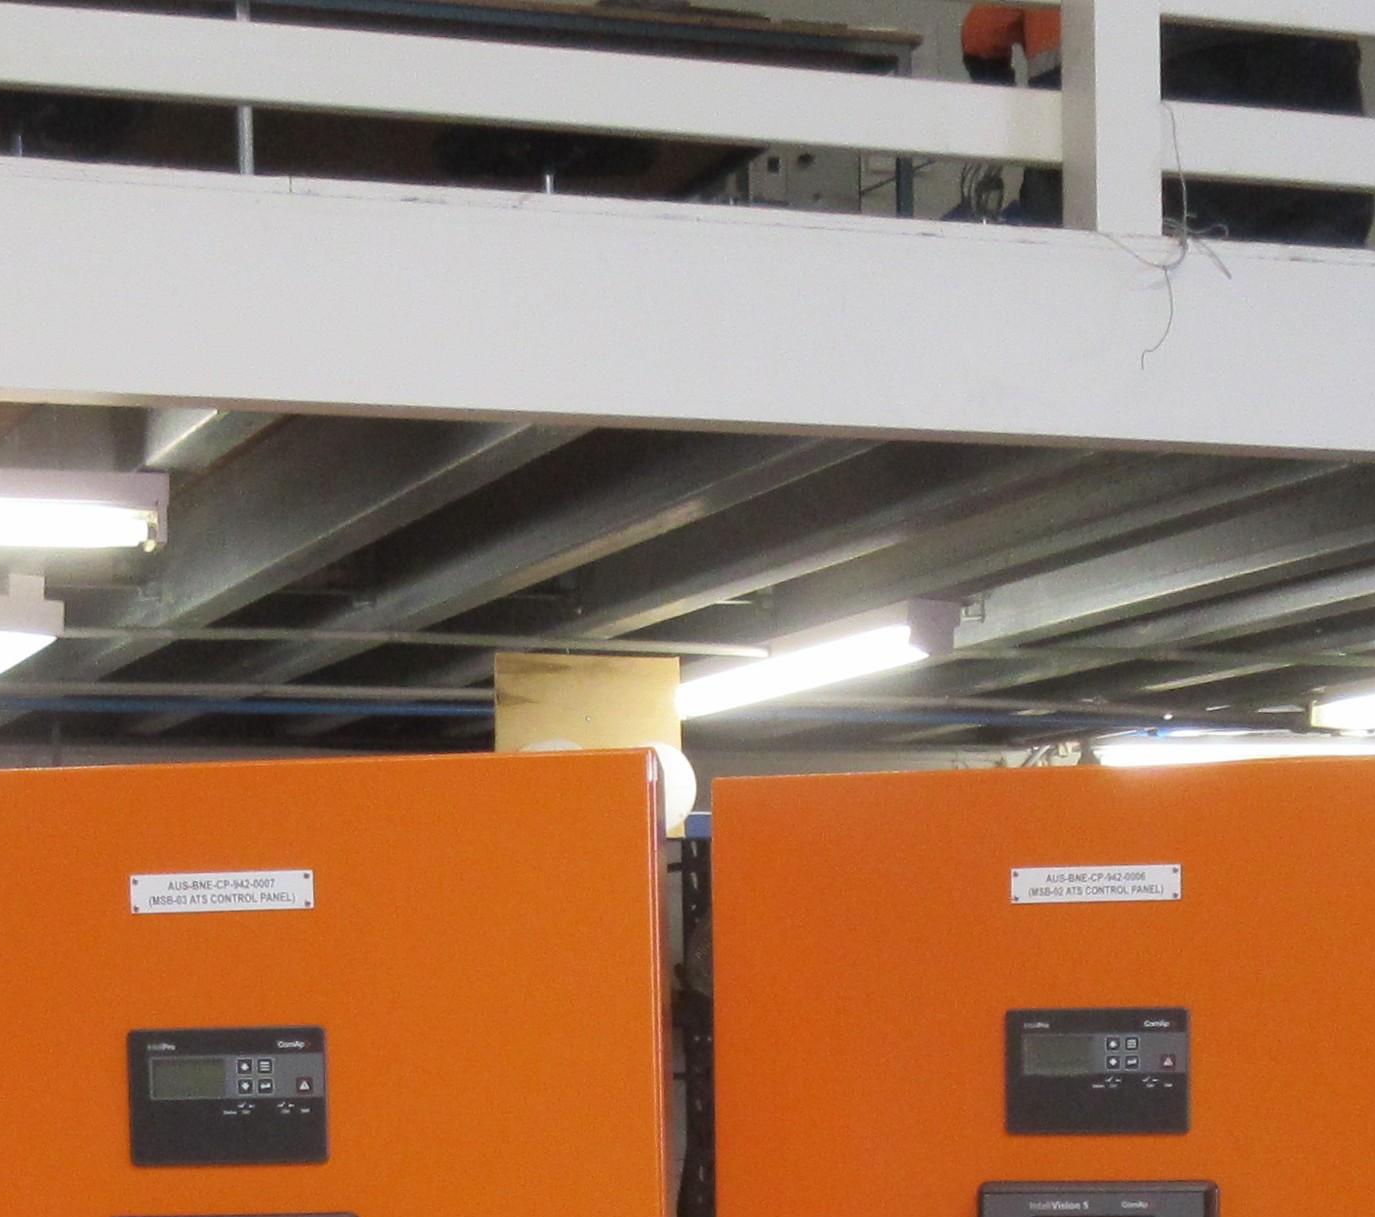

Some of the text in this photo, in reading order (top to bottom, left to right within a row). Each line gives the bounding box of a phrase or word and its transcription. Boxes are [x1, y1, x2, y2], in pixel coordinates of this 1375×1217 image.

[167, 878, 276, 892] AUS-BNE-CP-942-0007
[1065, 885, 1084, 896] ATS
[1085, 884, 1129, 896] CONTROL
[1131, 882, 1164, 896] PANEL)
[149, 890, 296, 908] (MSB-03 ATS CONTROL PANEL)
